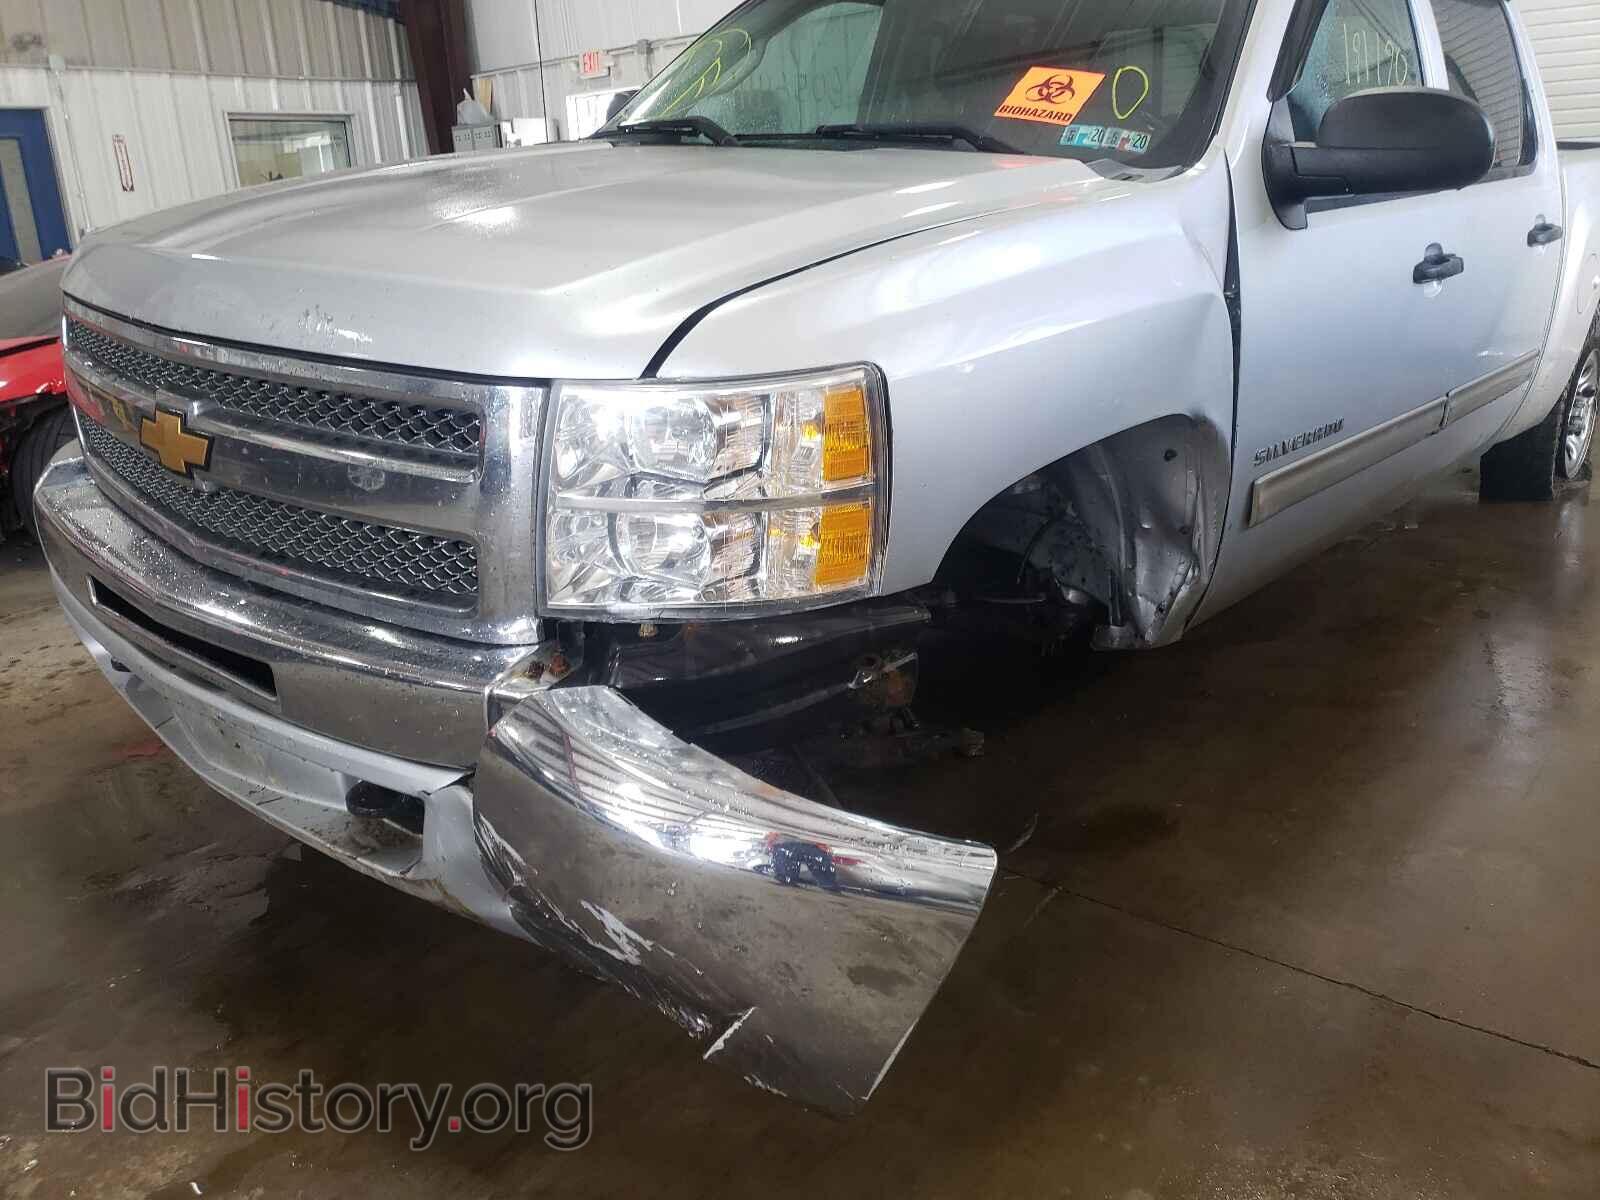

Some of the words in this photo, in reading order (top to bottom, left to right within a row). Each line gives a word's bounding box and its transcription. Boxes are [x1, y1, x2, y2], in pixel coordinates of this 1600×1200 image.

[582, 51, 601, 73] EXIT
[998, 104, 1073, 122] BIOHAZARD
[1133, 133, 1148, 149] 20
